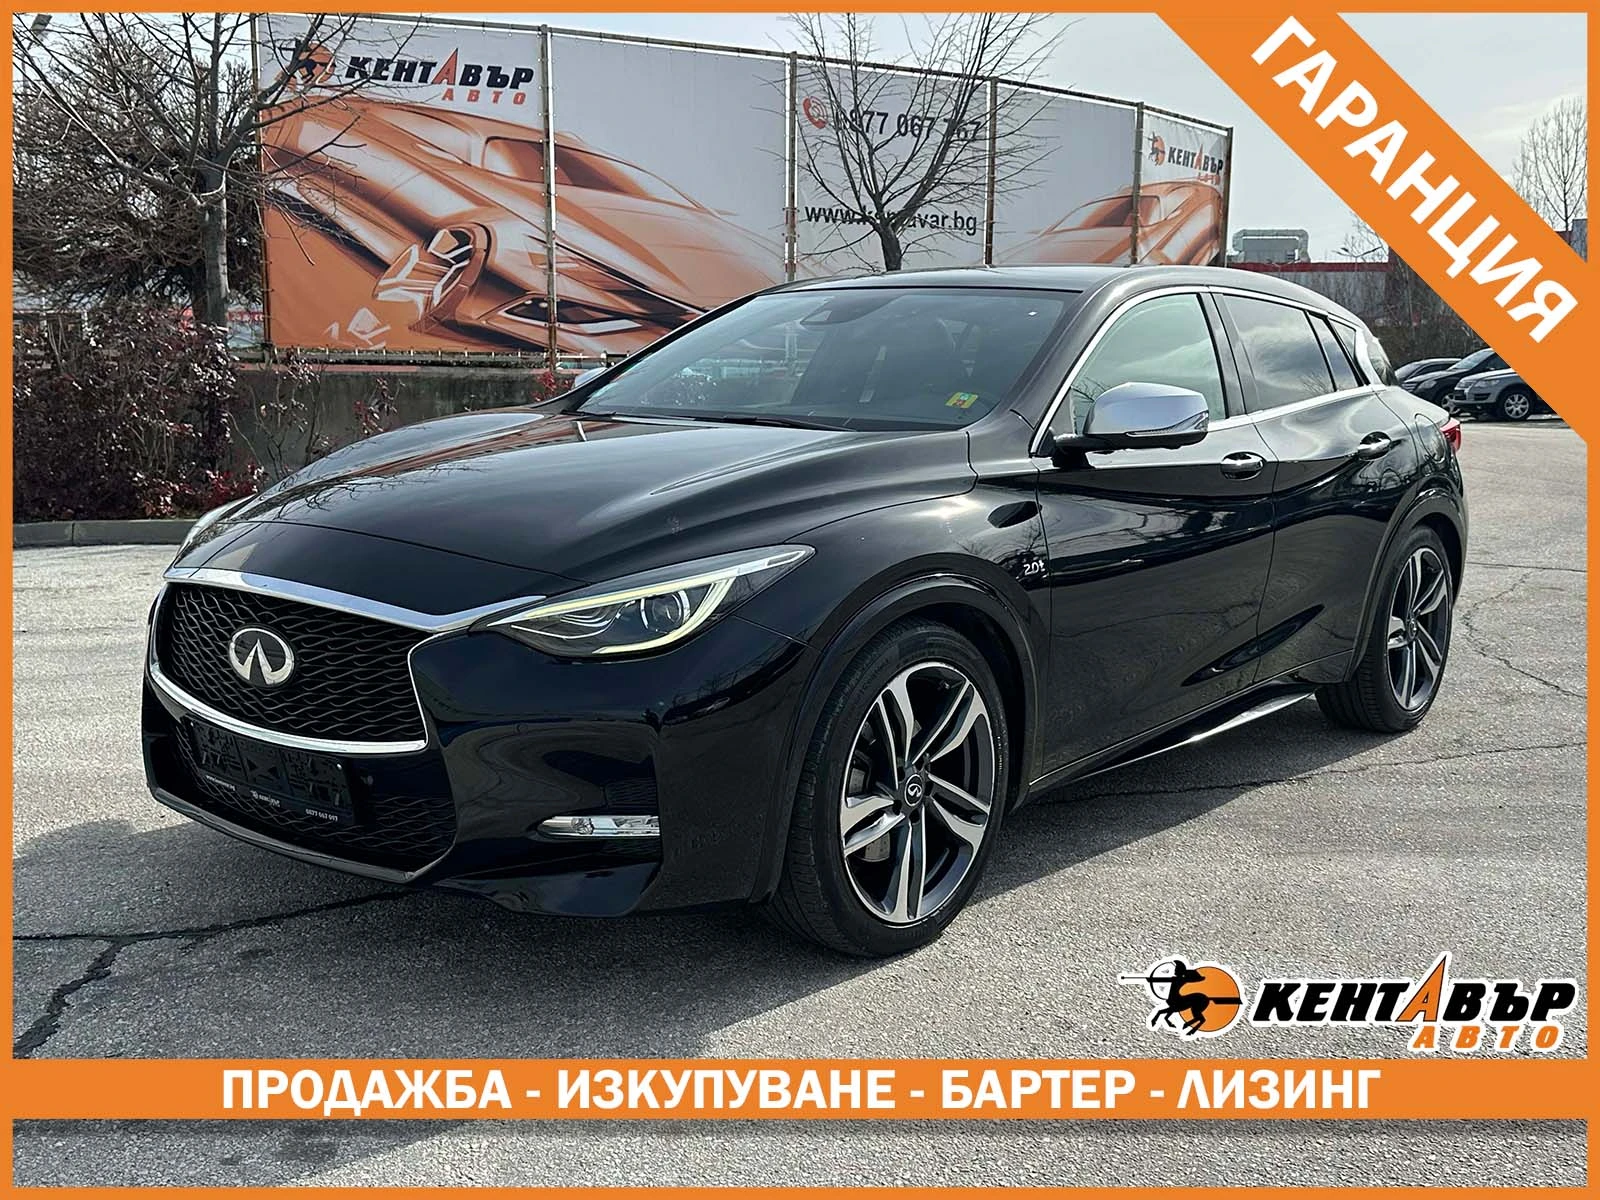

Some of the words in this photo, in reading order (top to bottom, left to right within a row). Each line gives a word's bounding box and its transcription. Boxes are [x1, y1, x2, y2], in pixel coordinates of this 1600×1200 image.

[345, 47, 534, 90] КЕНТАВЪР
[441, 87, 527, 105] АВТО
[1167, 143, 1224, 175] КЕНТАВЪР
